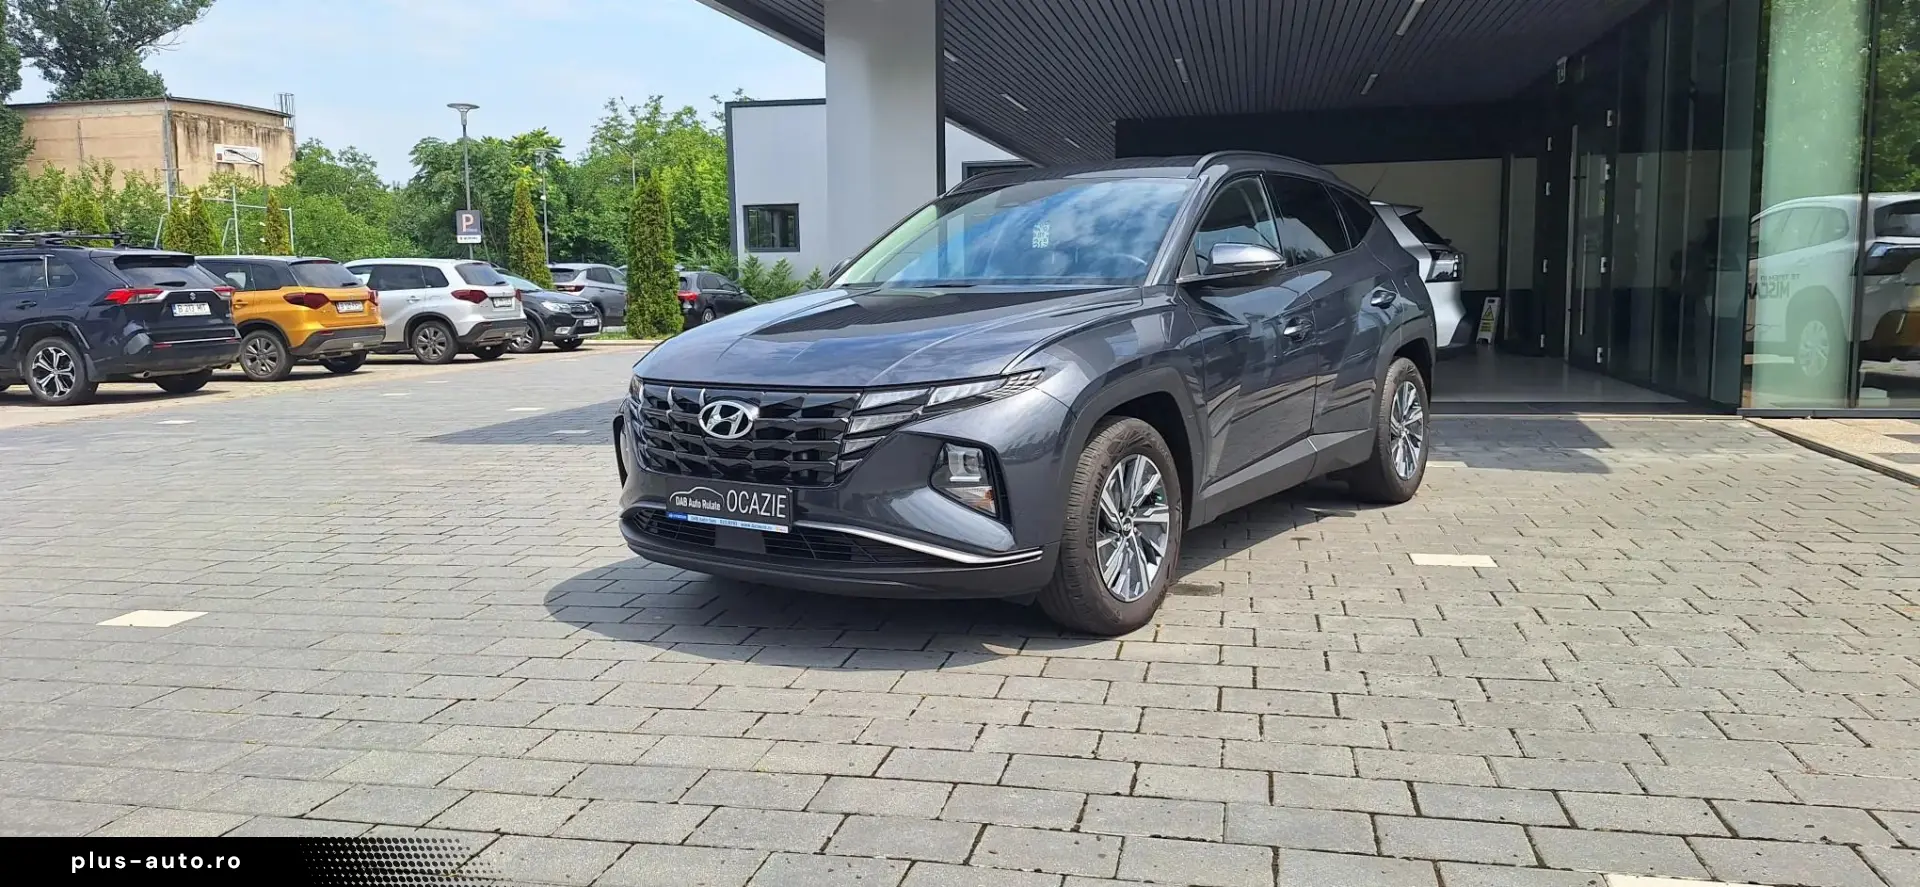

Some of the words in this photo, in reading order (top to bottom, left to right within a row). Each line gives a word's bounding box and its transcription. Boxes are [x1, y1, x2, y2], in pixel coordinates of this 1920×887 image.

[462, 214, 474, 232] P
[177, 304, 183, 313] B
[675, 496, 688, 507] DAB
[688, 498, 701, 509] Auto
[702, 499, 721, 511] Rulate
[726, 489, 787, 518] OCAZIE
